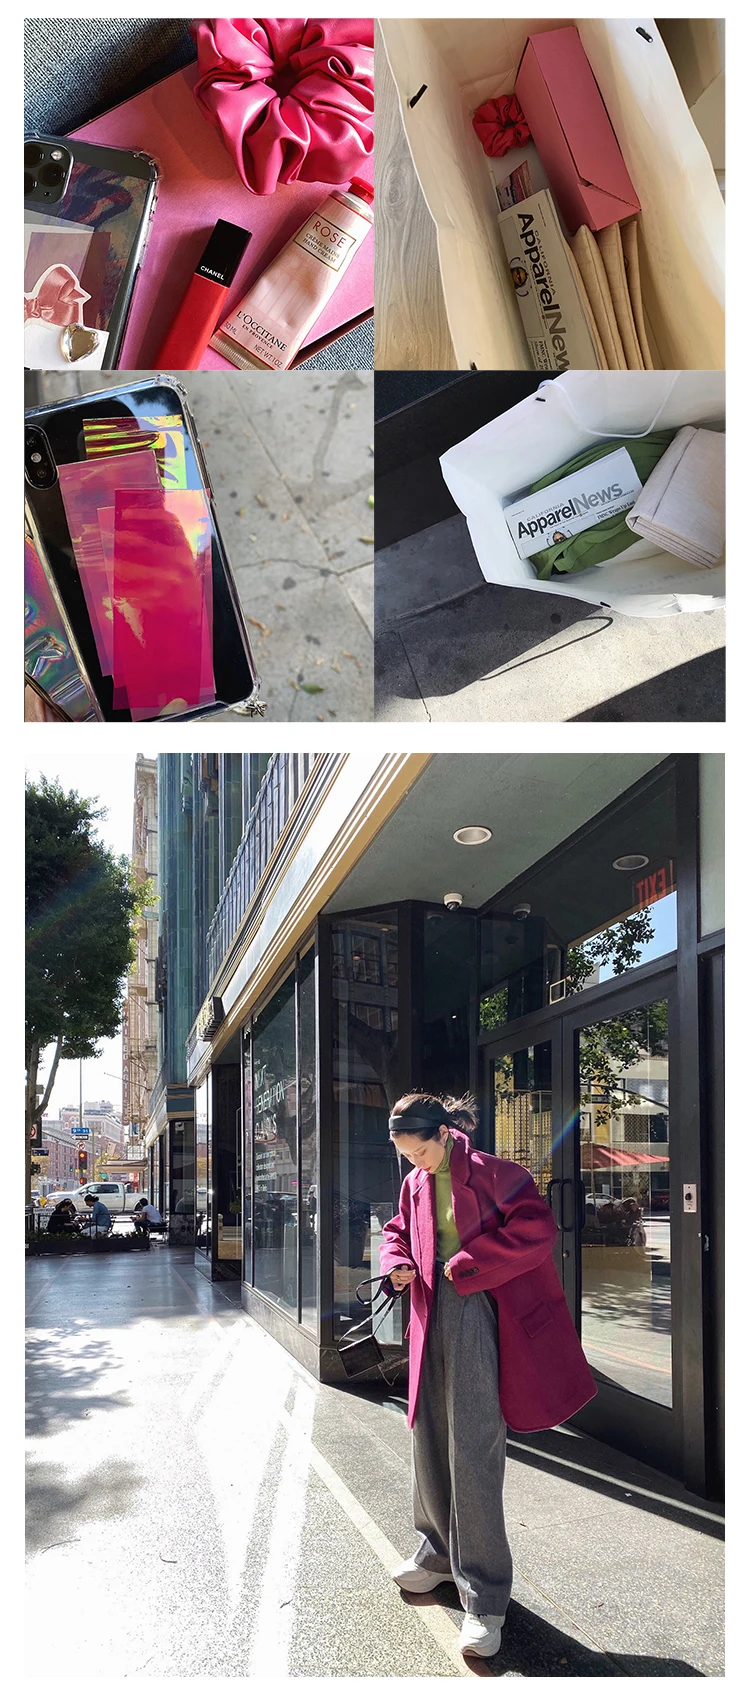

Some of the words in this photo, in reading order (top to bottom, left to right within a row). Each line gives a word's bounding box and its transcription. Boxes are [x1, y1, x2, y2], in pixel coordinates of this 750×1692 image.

[313, 221, 347, 248] ROSE
[302, 238, 318, 251] HAND
[317, 248, 336, 263] CREAM
[535, 230, 556, 296] CALIFORNIA
[200, 266, 225, 280] CHANEL
[236, 311, 288, 352] L'OCCITANE
[249, 328, 273, 349] PROVENCE
[253, 344, 265, 354] NET
[517, 482, 623, 539] ApparelNews
[527, 502, 565, 522] CALIFORNIA
